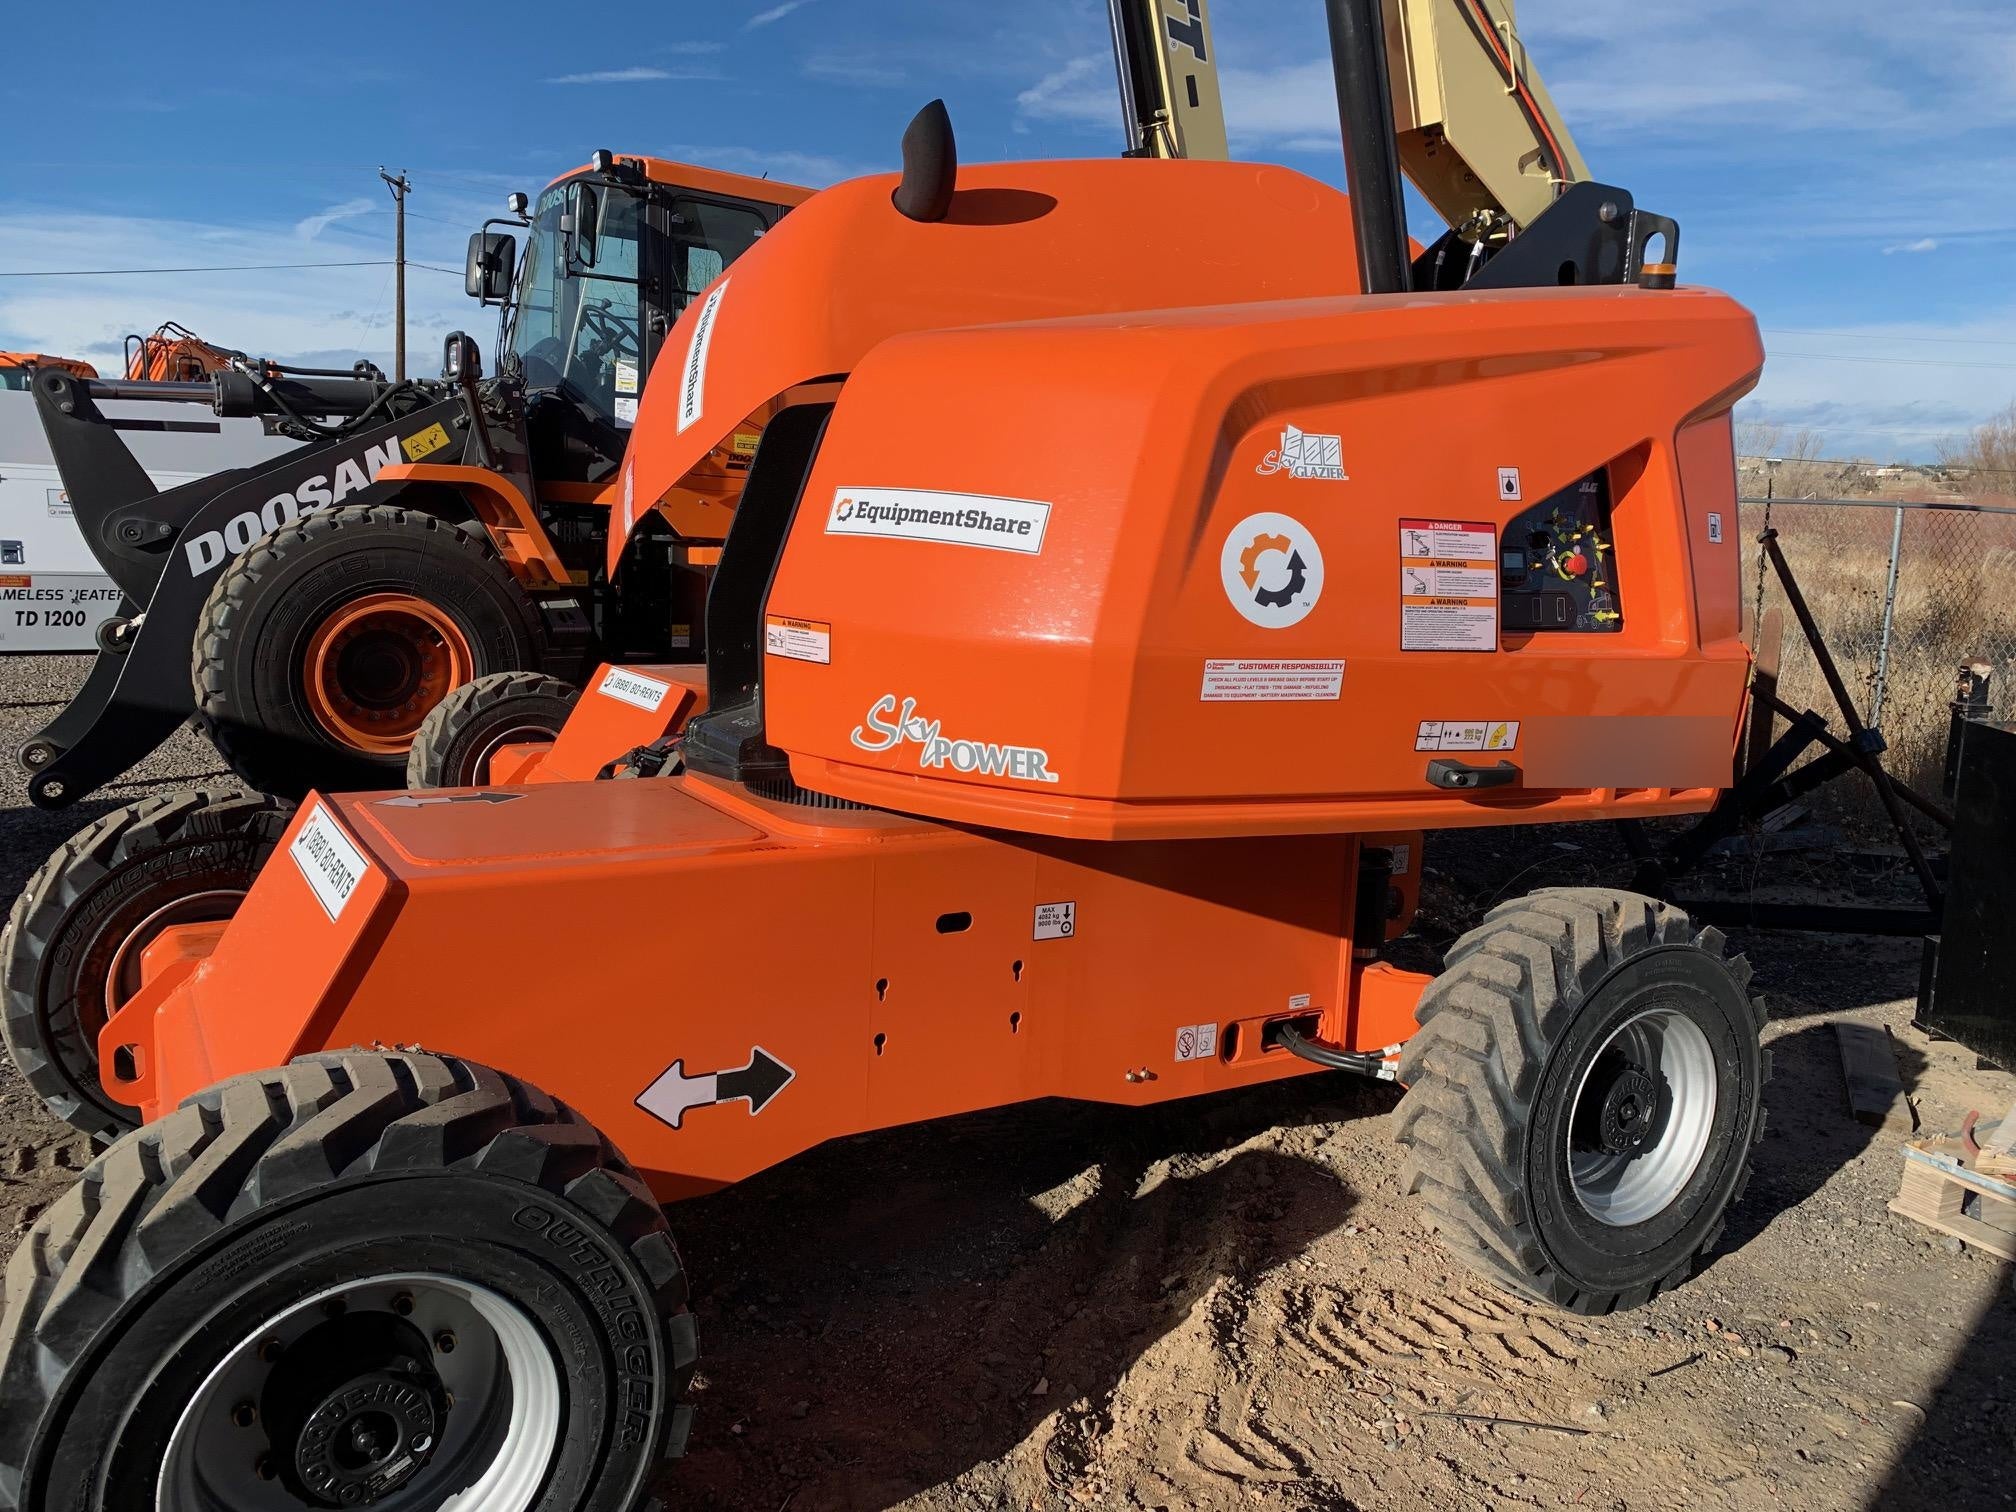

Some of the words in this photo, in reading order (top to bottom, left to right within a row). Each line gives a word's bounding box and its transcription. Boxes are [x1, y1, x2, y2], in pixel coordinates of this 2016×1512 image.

[1295, 466, 1345, 479] GLAZIER
[1579, 482, 1598, 492] JLG
[184, 435, 404, 578] DOOSAN
[854, 501, 1032, 536] EquipmentShare
[0, 589, 64, 600] MELESS
[15, 611, 38, 626] TD
[44, 610, 86, 626] 1200
[787, 620, 811, 629] WARNING
[851, 694, 940, 768] Sky
[934, 739, 1049, 781] POWER
[512, 1205, 654, 1444] OUTRIGGER
